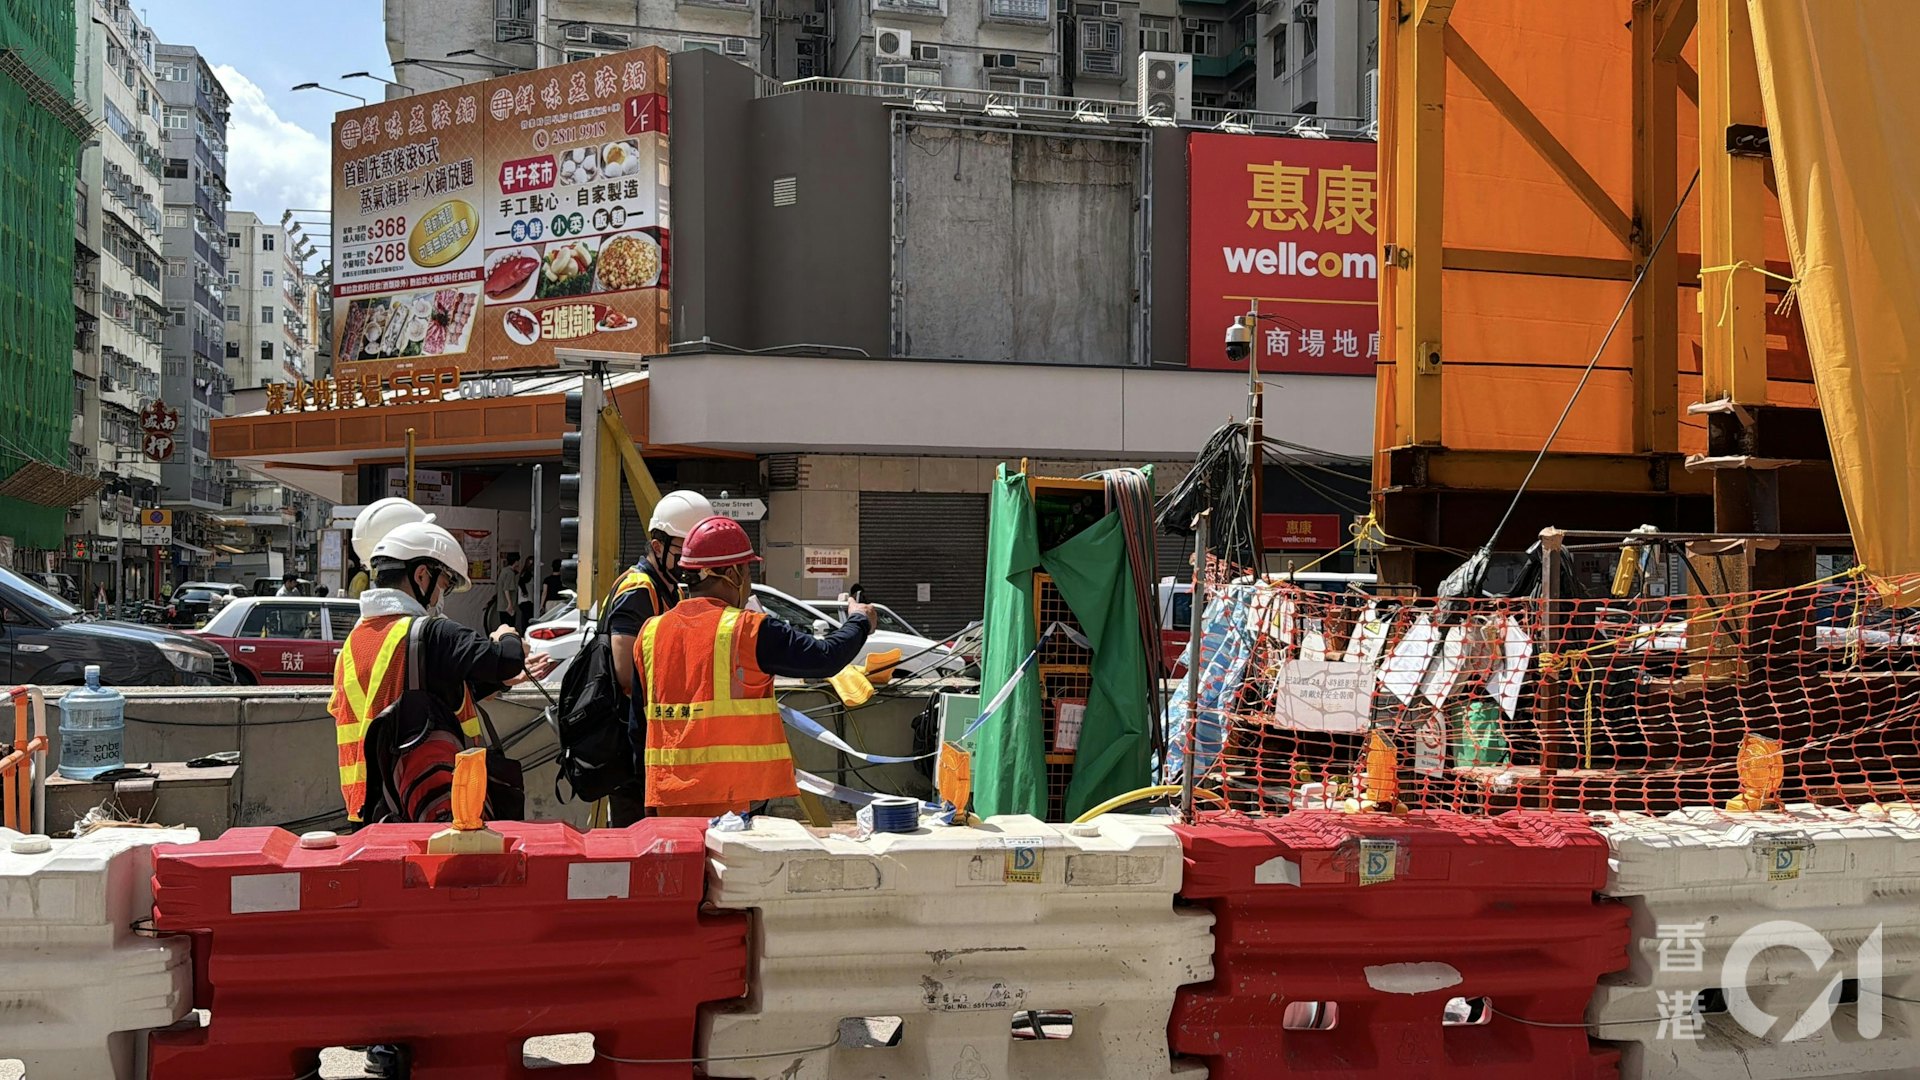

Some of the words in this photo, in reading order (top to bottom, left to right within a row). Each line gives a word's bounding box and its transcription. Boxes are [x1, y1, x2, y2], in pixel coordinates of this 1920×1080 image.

[552, 126, 576, 145] 2811
[579, 121, 606, 140] 9918
[502, 160, 553, 190] 早午茶市
[1246, 160, 1377, 236] 惠康
[367, 216, 406, 240] $368
[512, 219, 542, 241] 海鮮
[552, 213, 583, 235] 小菜
[367, 242, 406, 265] $268
[146, 436, 171, 459] 押
[1286, 520, 1312, 535] 惠康
[1282, 535, 1317, 544] wellcome
[281, 651, 304, 661] 的士
[281, 660, 304, 671] TAXI
[655, 704, 703, 718] 安全第一
[94, 741, 120, 753] aqua
[101, 750, 120, 760] bon
